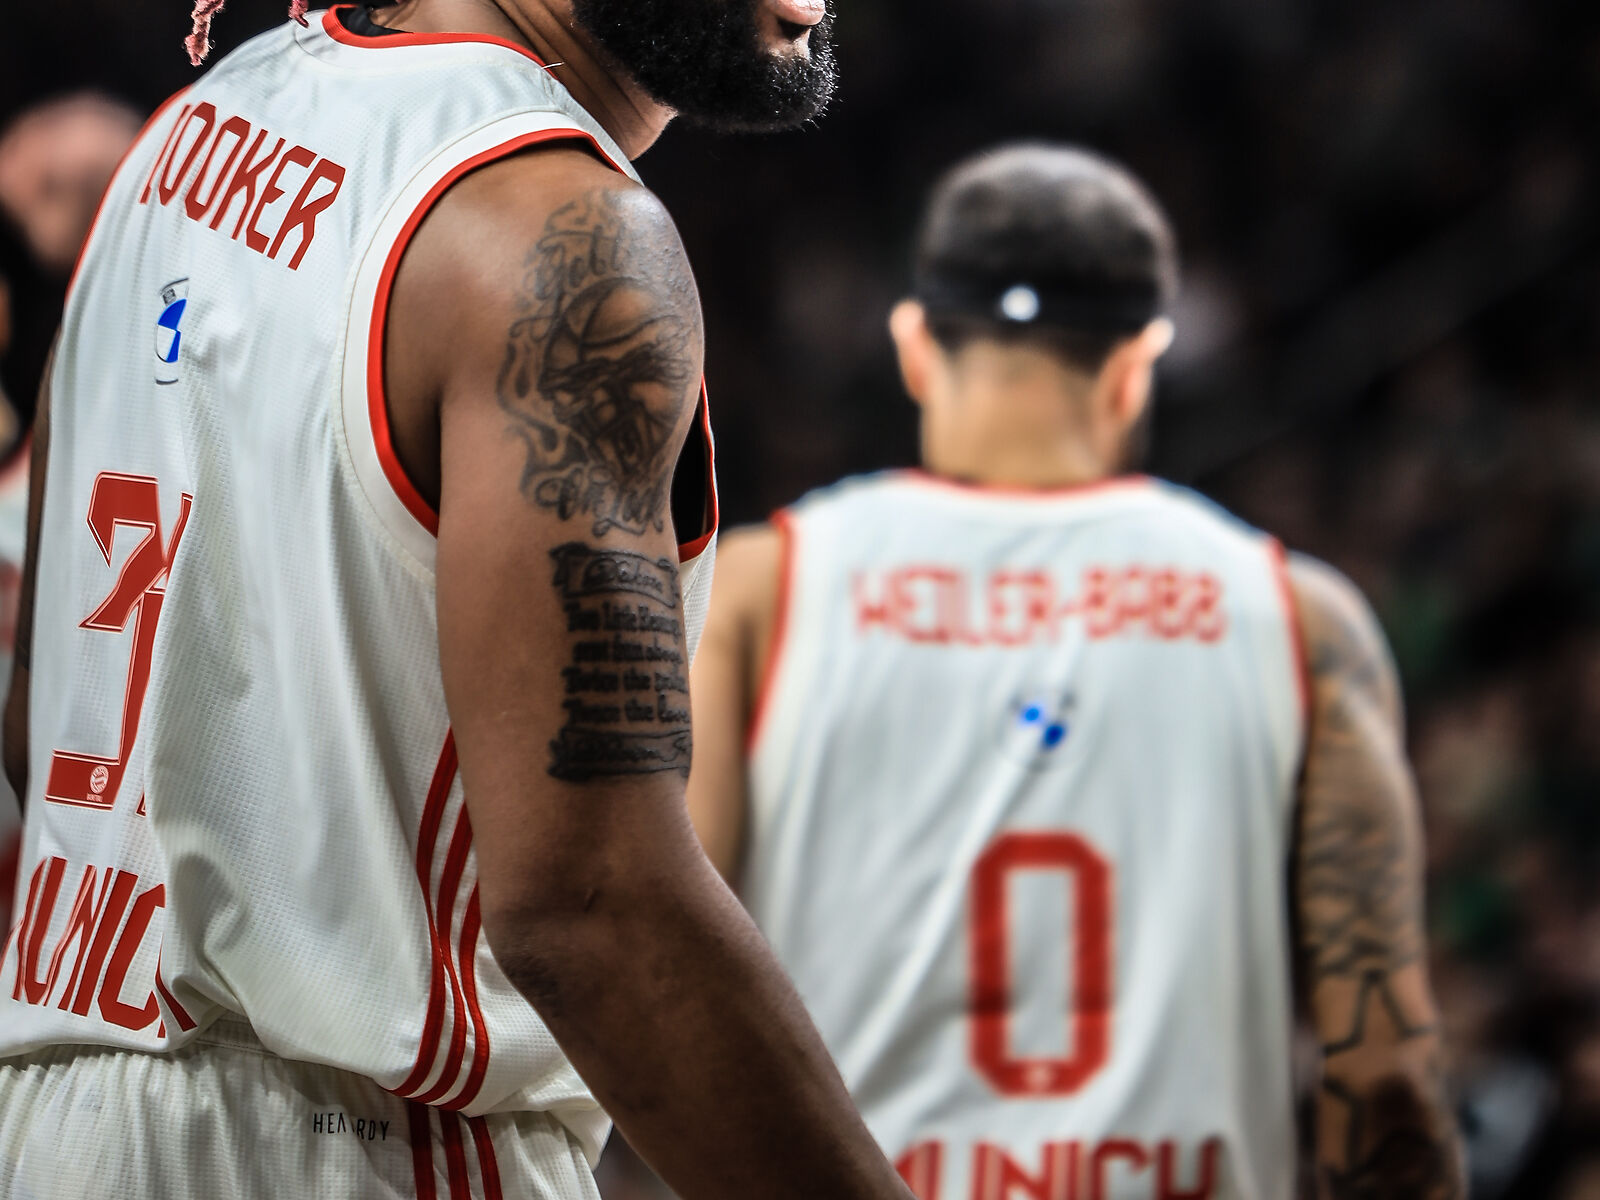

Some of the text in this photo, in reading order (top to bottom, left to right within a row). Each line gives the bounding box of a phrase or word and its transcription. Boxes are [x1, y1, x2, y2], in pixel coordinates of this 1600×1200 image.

[0, 855, 197, 1038] UNIC
[966, 830, 1114, 1098] 0
[313, 1112, 389, 1141] HEARDY
[893, 1134, 1226, 1200] UNICH
